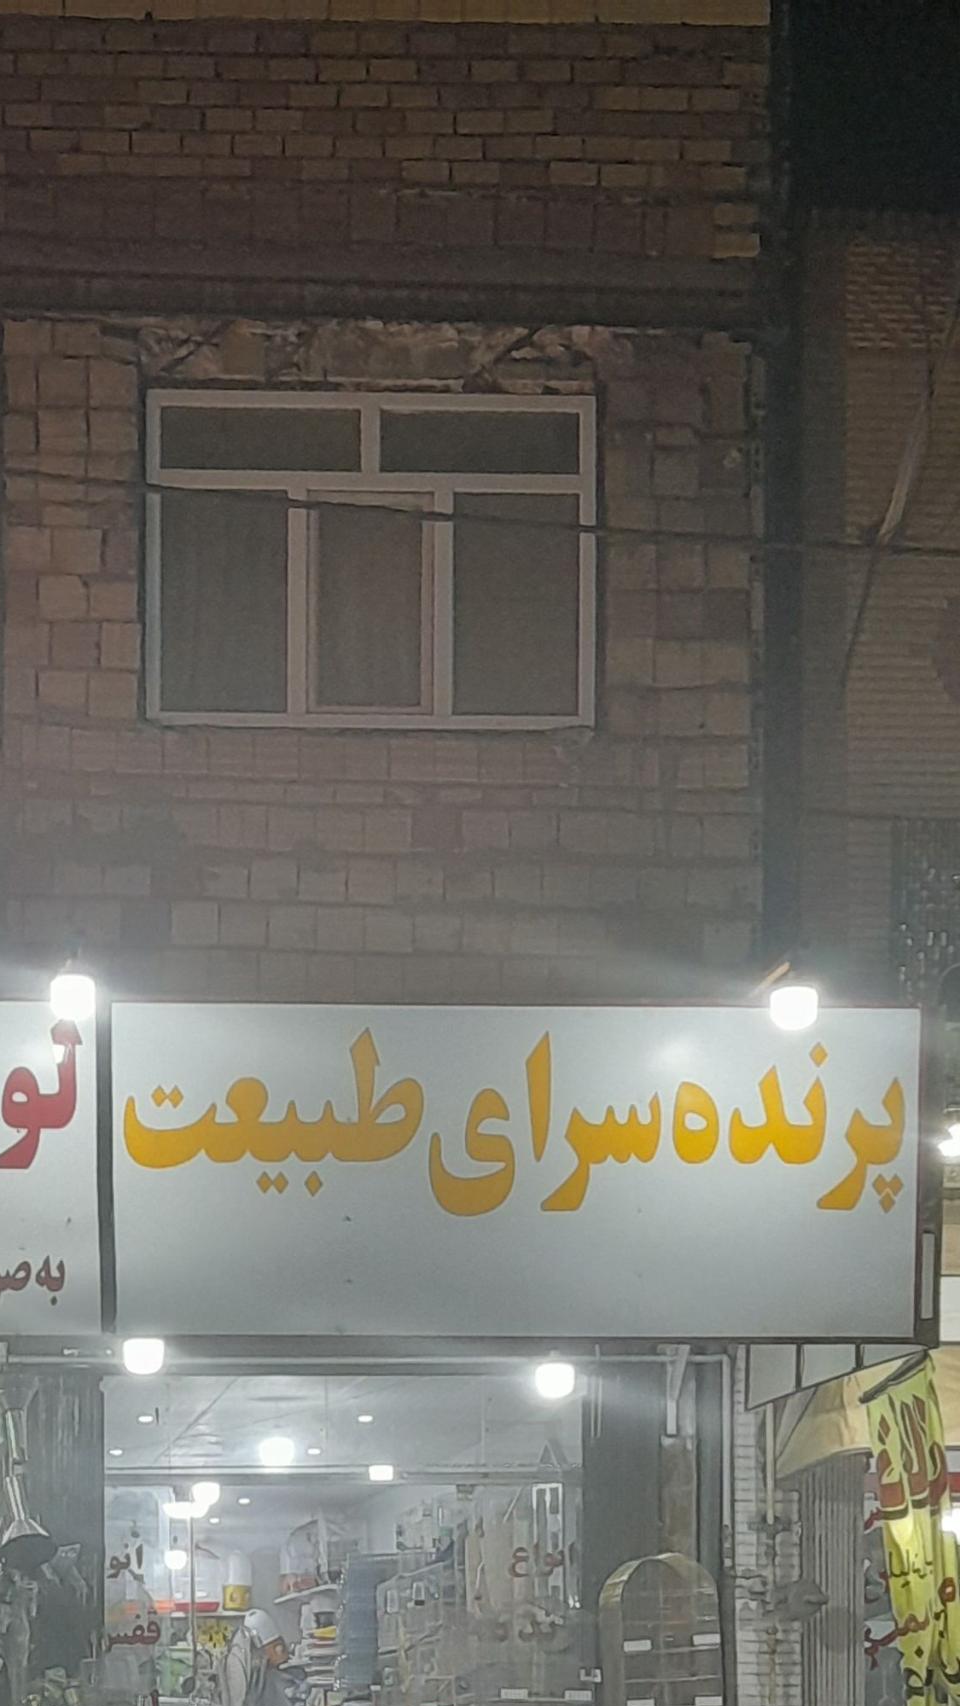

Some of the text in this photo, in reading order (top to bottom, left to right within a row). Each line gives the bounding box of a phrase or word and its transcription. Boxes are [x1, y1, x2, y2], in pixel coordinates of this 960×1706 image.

[123, 1027, 905, 1216] پرنده سرای طبیعت
